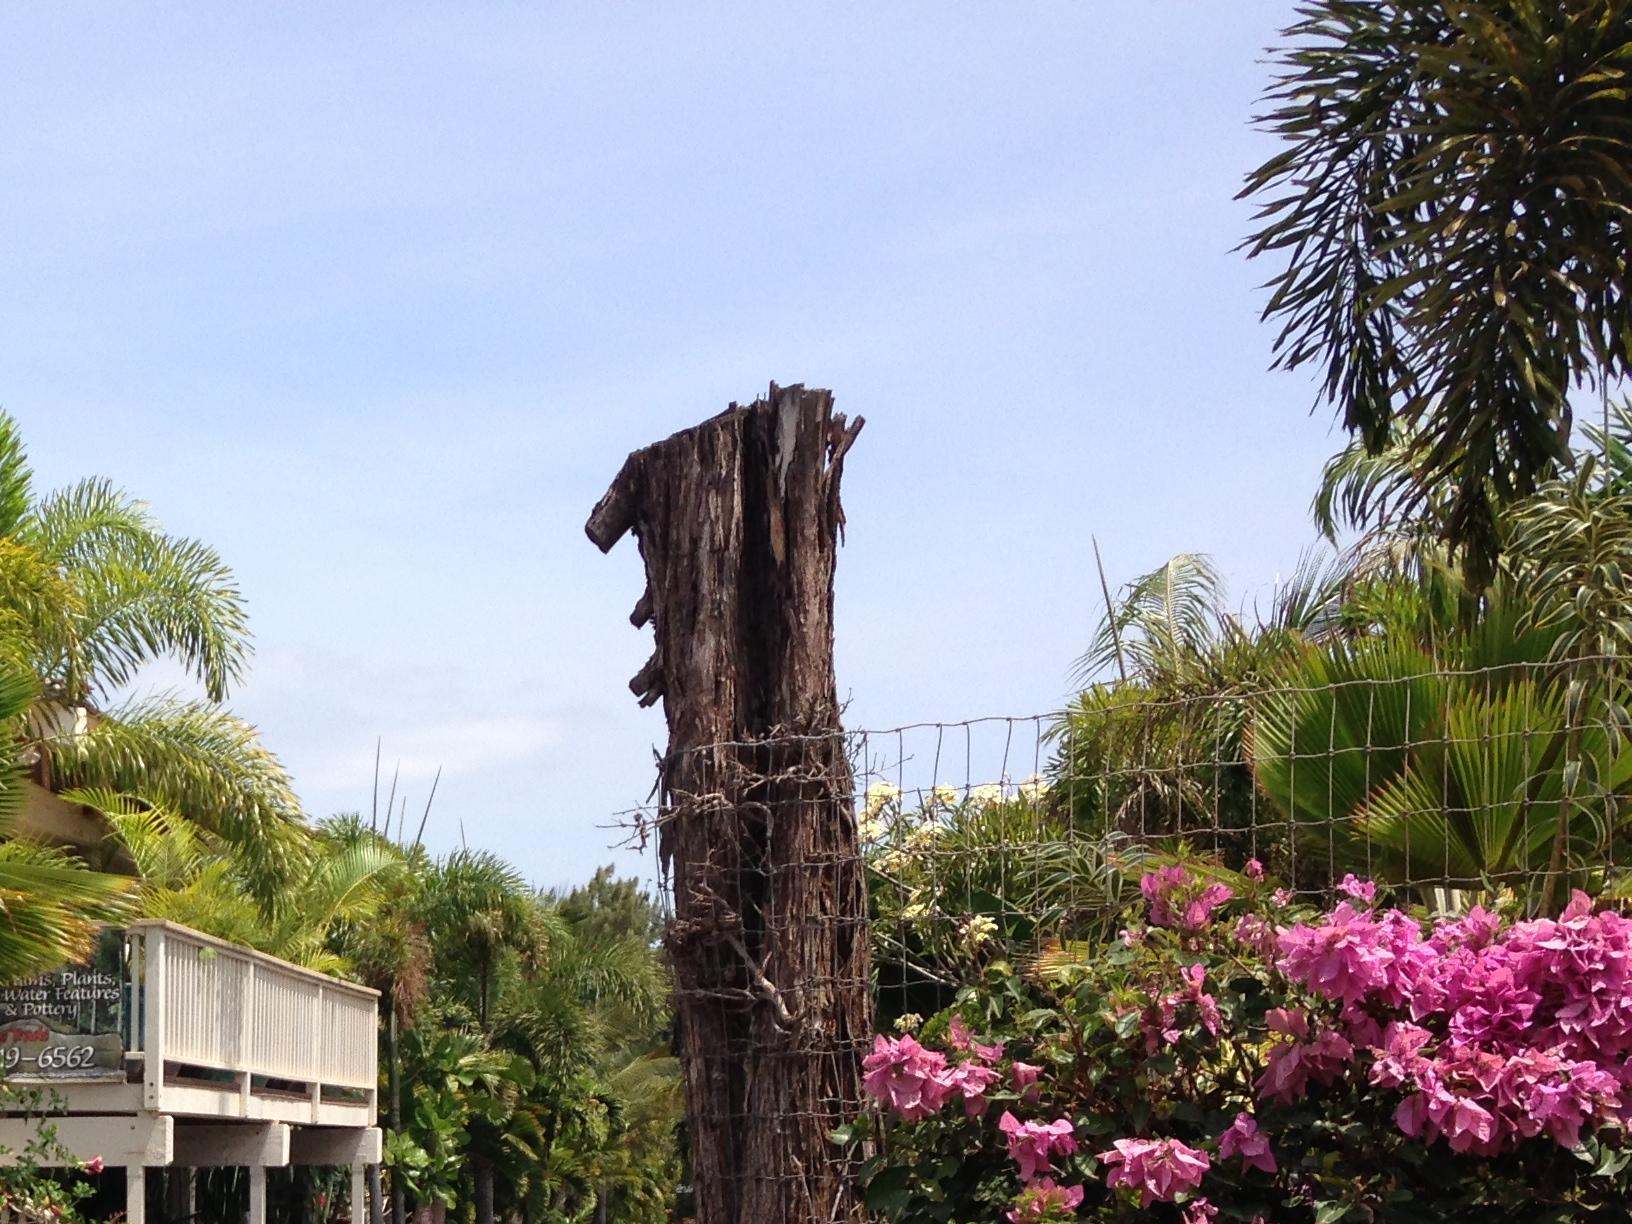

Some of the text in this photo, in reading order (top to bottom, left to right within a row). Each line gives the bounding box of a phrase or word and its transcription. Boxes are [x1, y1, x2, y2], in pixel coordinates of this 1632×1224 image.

[62, 971, 116, 986] Plants,
[1, 987, 120, 1001] Water Features
[5, 1002, 77, 1019] & Pottery
